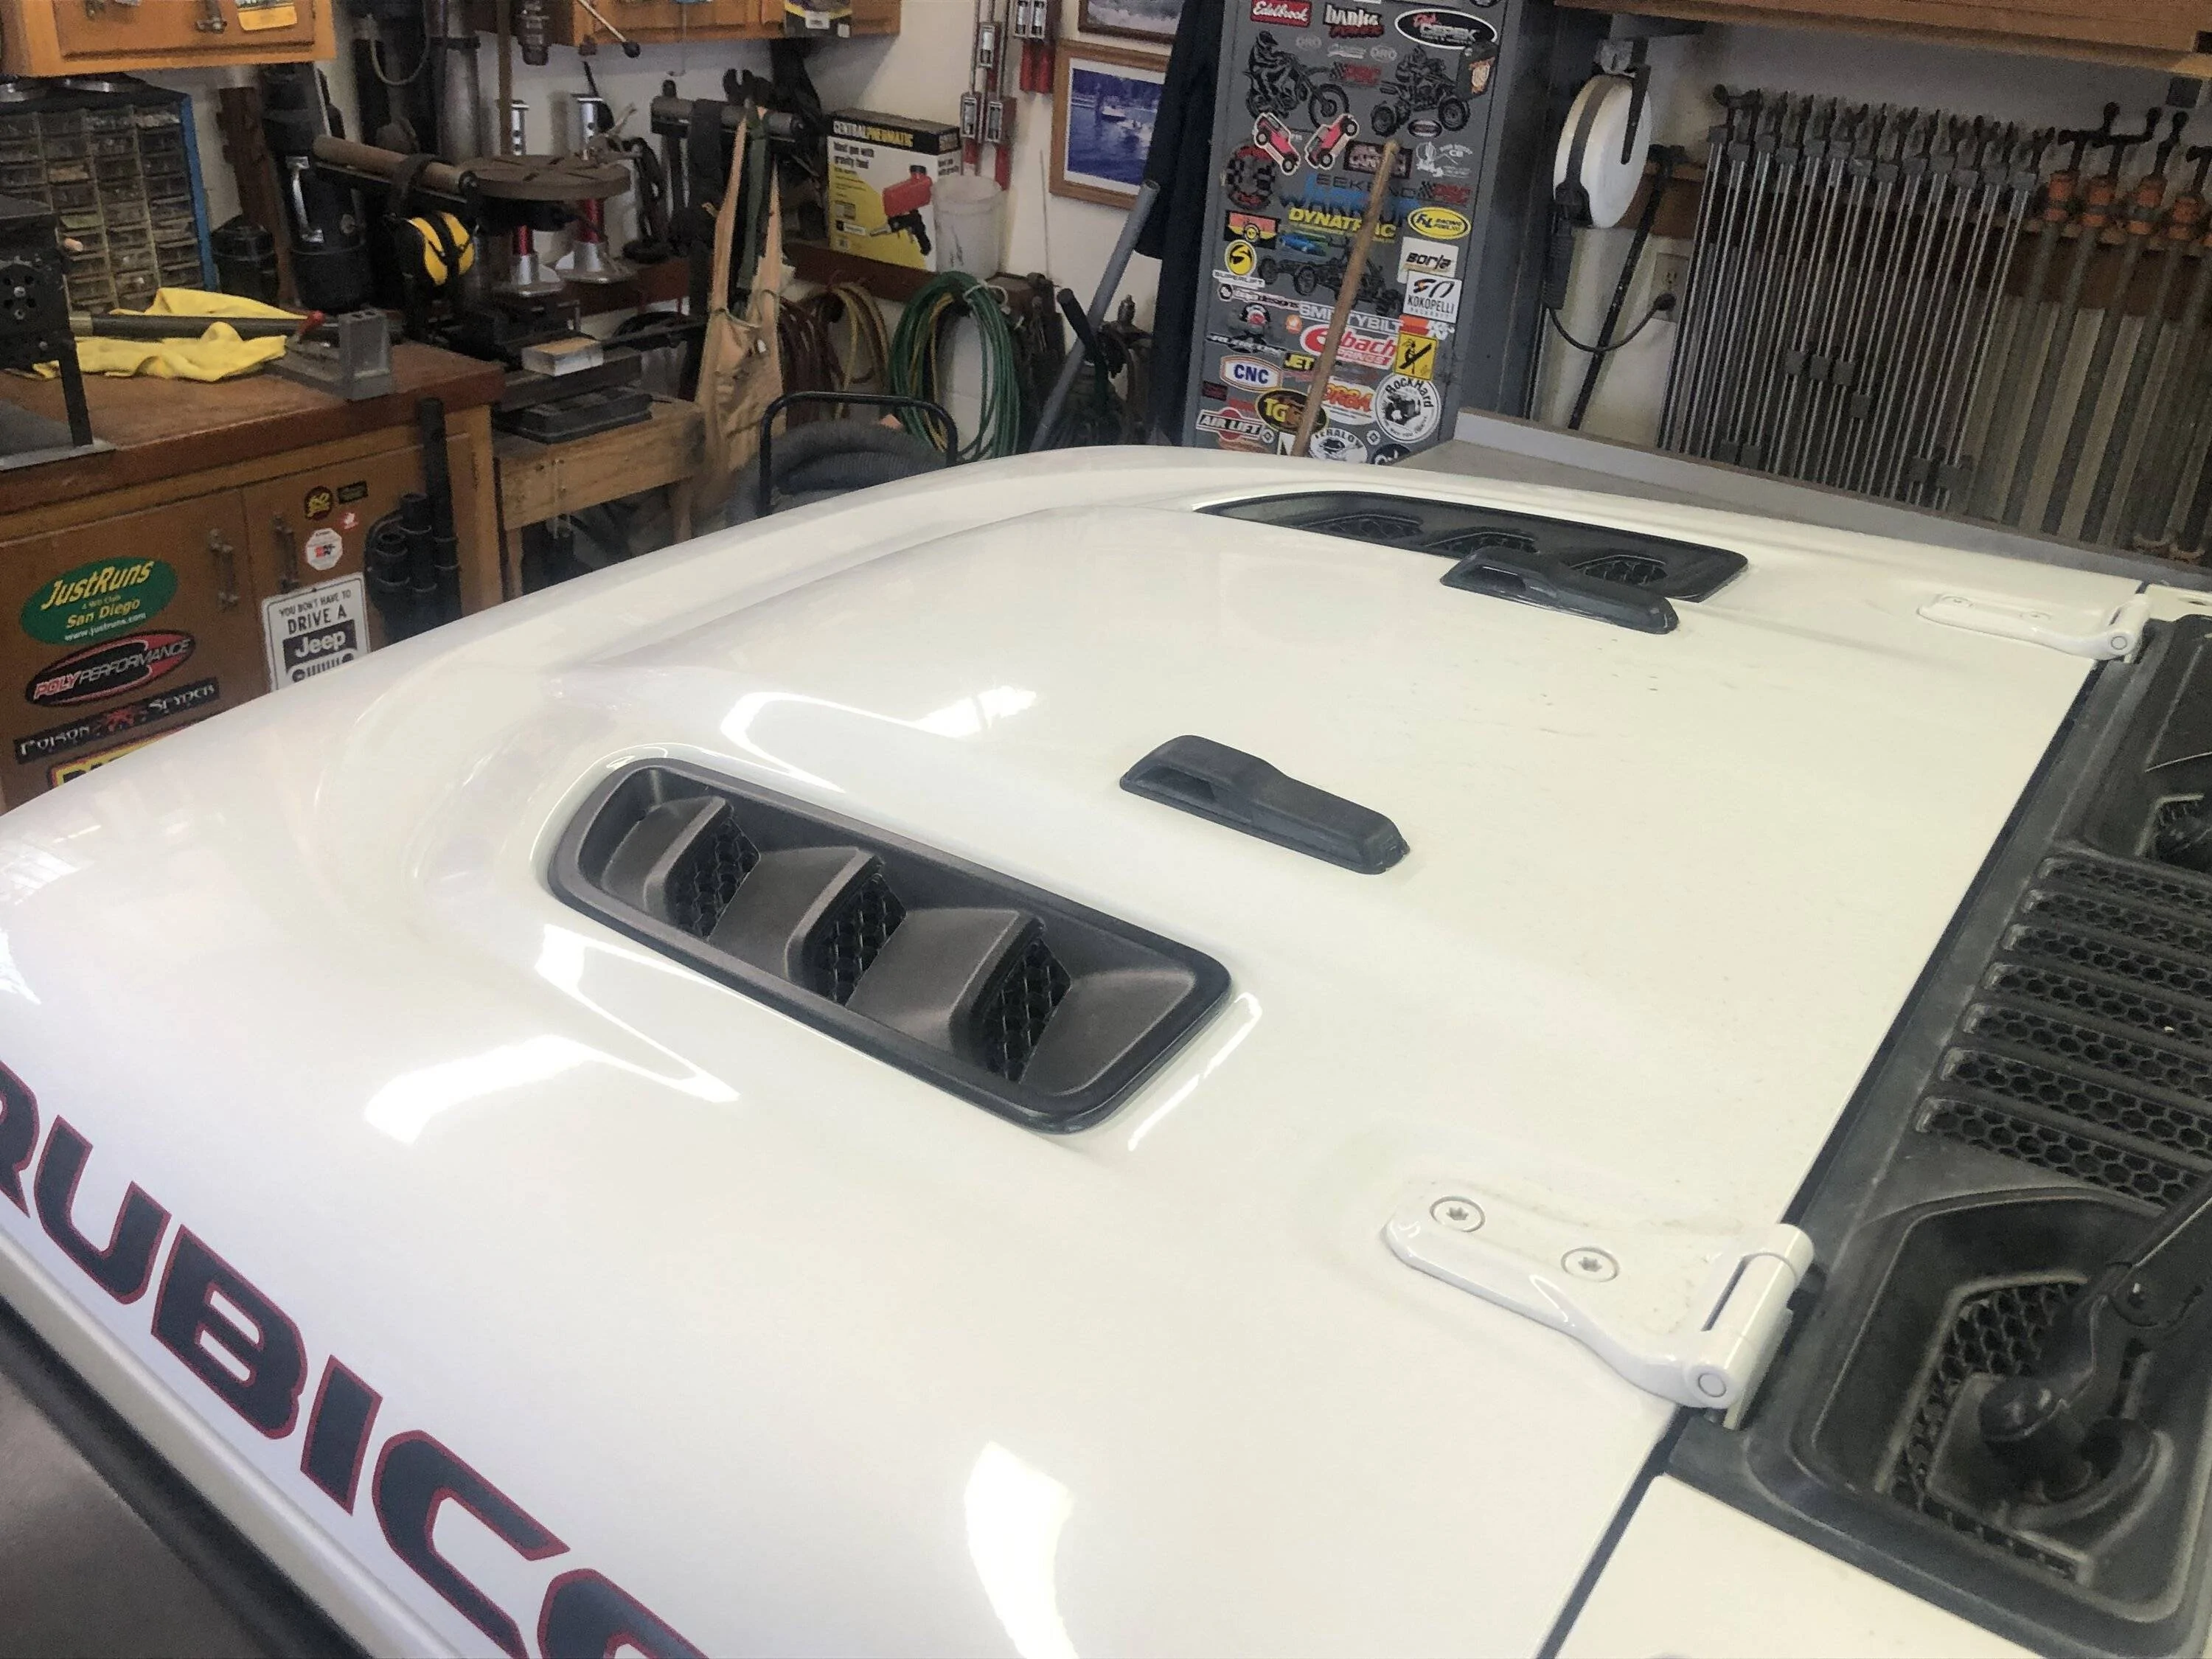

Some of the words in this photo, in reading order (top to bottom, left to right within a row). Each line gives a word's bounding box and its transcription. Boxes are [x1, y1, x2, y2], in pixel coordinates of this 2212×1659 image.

[1408, 294, 1454, 314] KOKOPELLI
[1299, 305, 1404, 332] SMITYBILT
[1284, 354, 1315, 370] JET
[1234, 364, 1269, 384] CNC
[1200, 415, 1226, 429] AIR
[1231, 420, 1261, 434] LIFT
[342, 589, 352, 599] TO
[66, 612, 94, 628] San
[99, 598, 140, 619] Diego
[288, 608, 331, 634] DRIVE
[338, 604, 347, 619] A
[295, 630, 347, 658] Jeep
